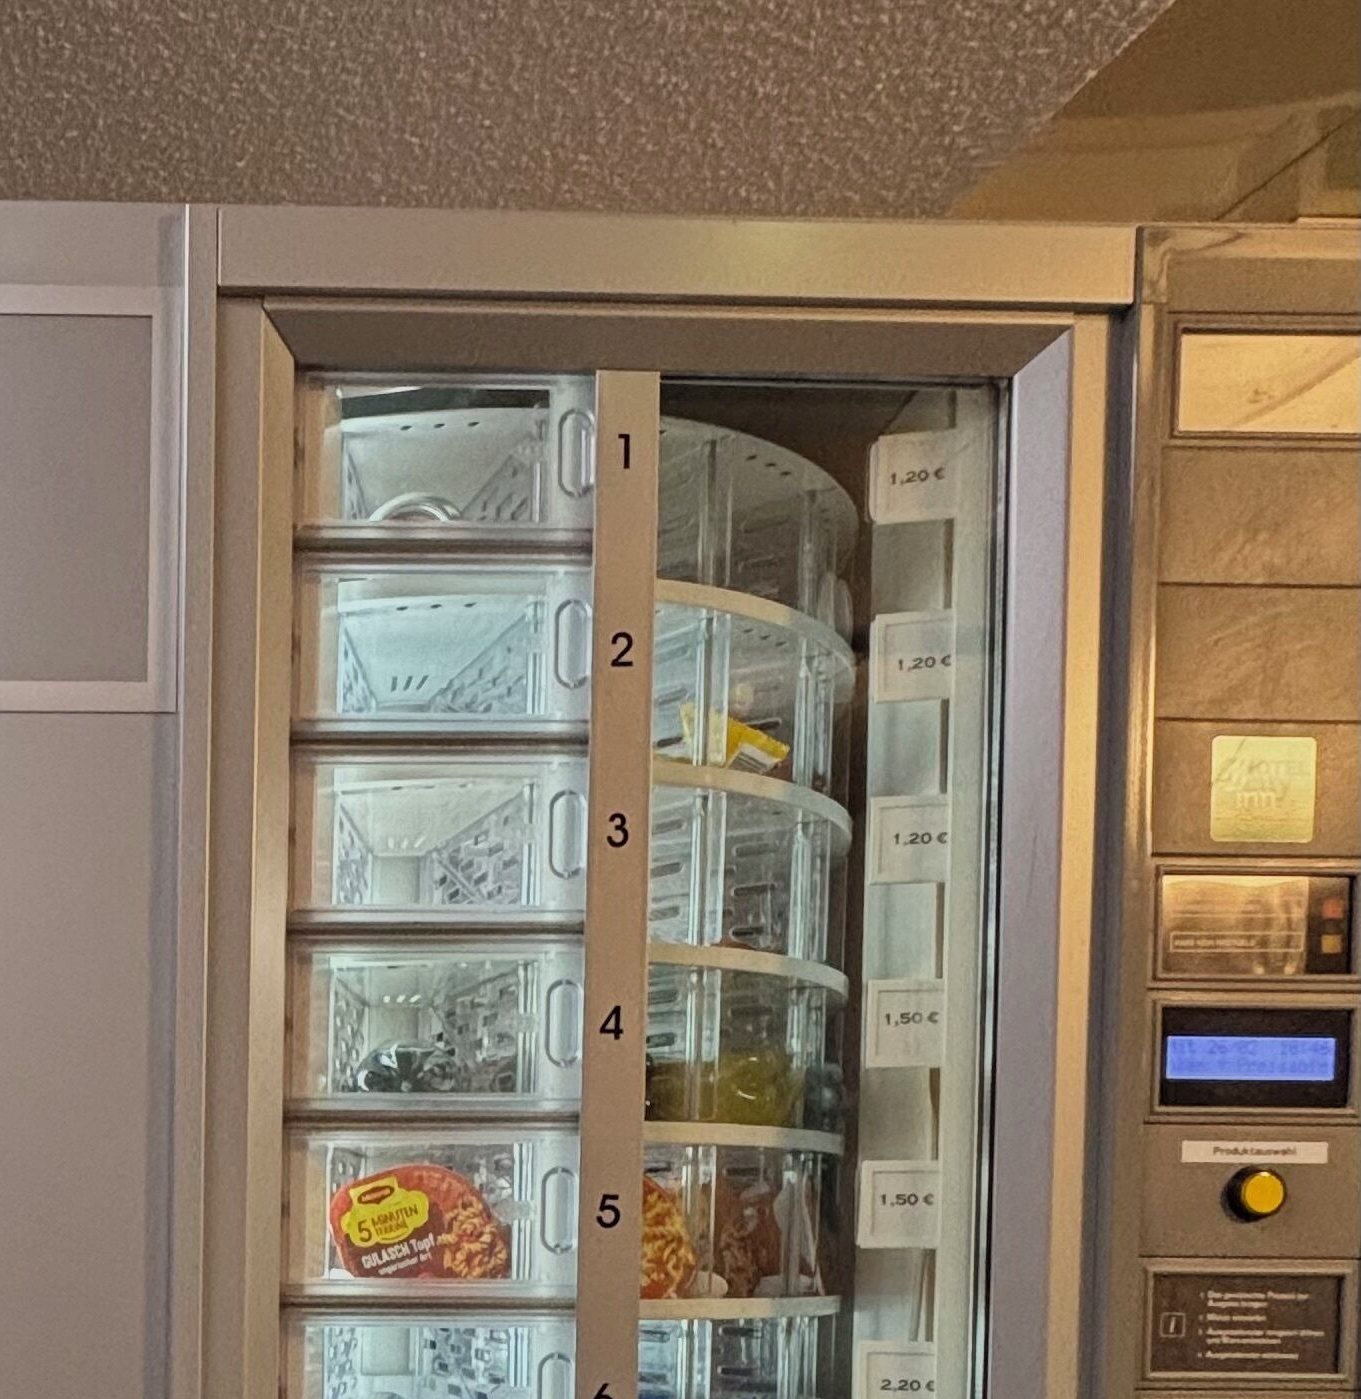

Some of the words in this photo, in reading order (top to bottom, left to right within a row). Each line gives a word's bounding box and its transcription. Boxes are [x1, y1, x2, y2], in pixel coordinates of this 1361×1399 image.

[618, 434, 631, 469] 1
[934, 467, 945, 480] €
[611, 633, 634, 667] 2
[941, 655, 951, 667] €
[607, 814, 629, 847] 3
[937, 831, 948, 844] €
[600, 1006, 624, 1040] 4
[927, 1012, 939, 1024] €
[923, 1193, 934, 1205] €
[596, 1194, 621, 1229] 5
[357, 1220, 373, 1243] 5
[925, 1380, 934, 1392] €
